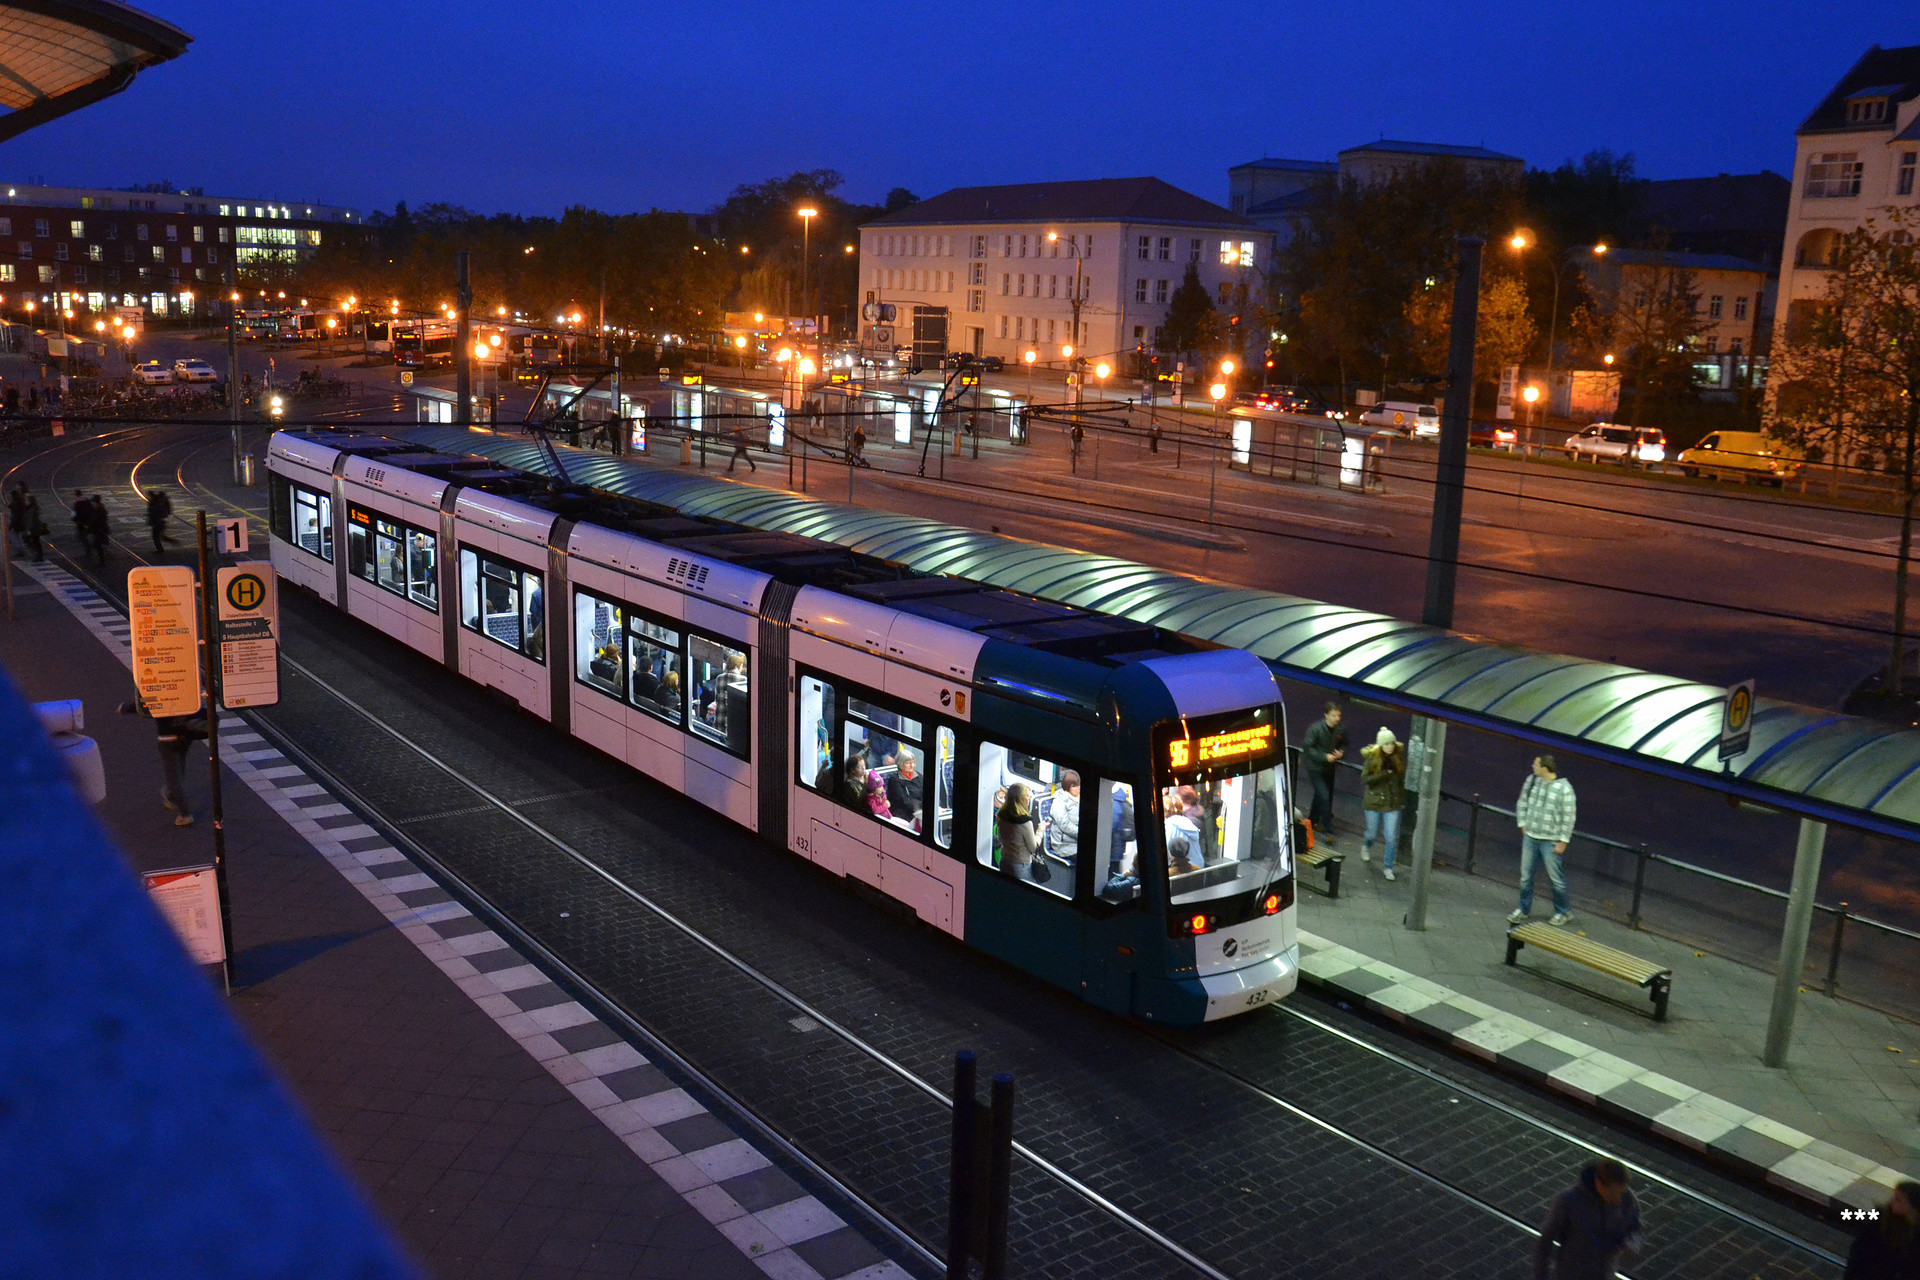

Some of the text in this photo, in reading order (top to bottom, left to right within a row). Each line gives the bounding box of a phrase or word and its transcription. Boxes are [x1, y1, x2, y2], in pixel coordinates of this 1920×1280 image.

[227, 522, 240, 548] 1
[238, 582, 254, 603] H
[796, 836, 809, 851] 432
[1246, 990, 1268, 1005] 432
